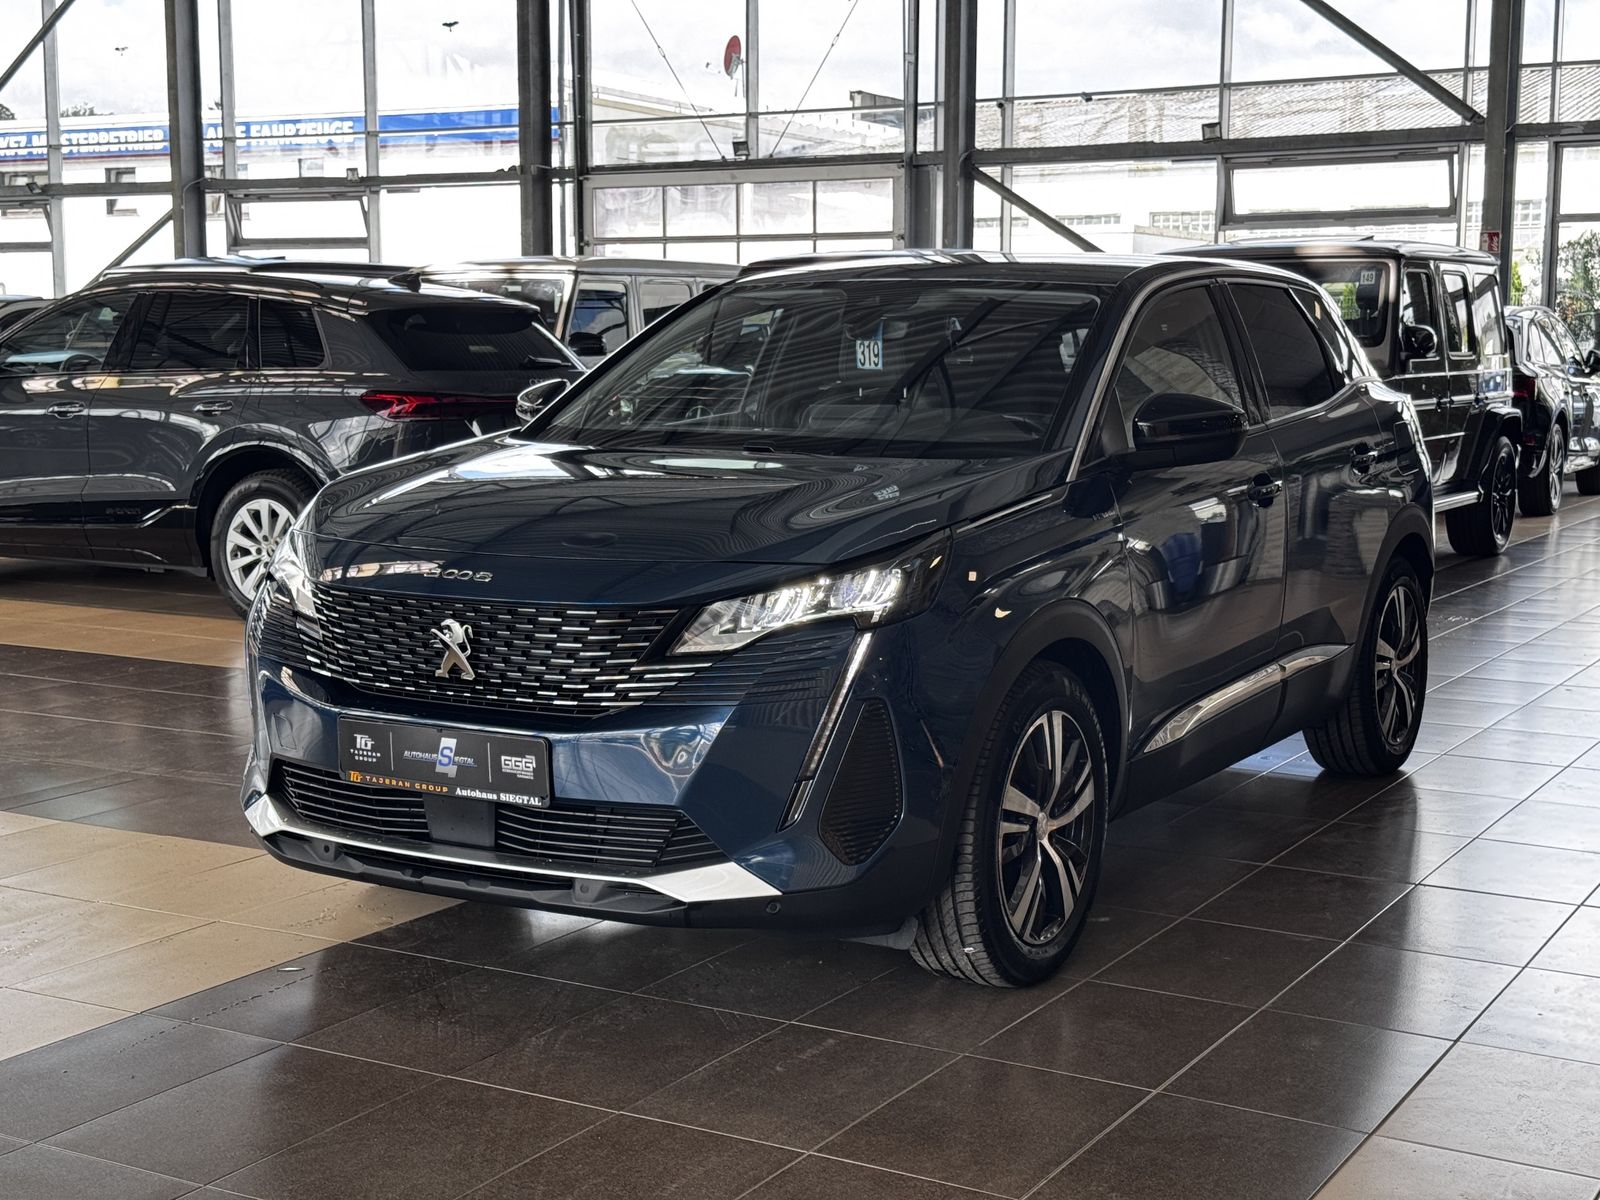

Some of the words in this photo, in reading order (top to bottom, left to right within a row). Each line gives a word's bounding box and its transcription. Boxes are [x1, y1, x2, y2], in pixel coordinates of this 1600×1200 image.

[858, 341, 880, 368] 319
[501, 755, 534, 771] GGG
[414, 783, 449, 793] GROUP
[455, 787, 498, 801] Autohaus
[499, 792, 542, 806] SIEGTAL
